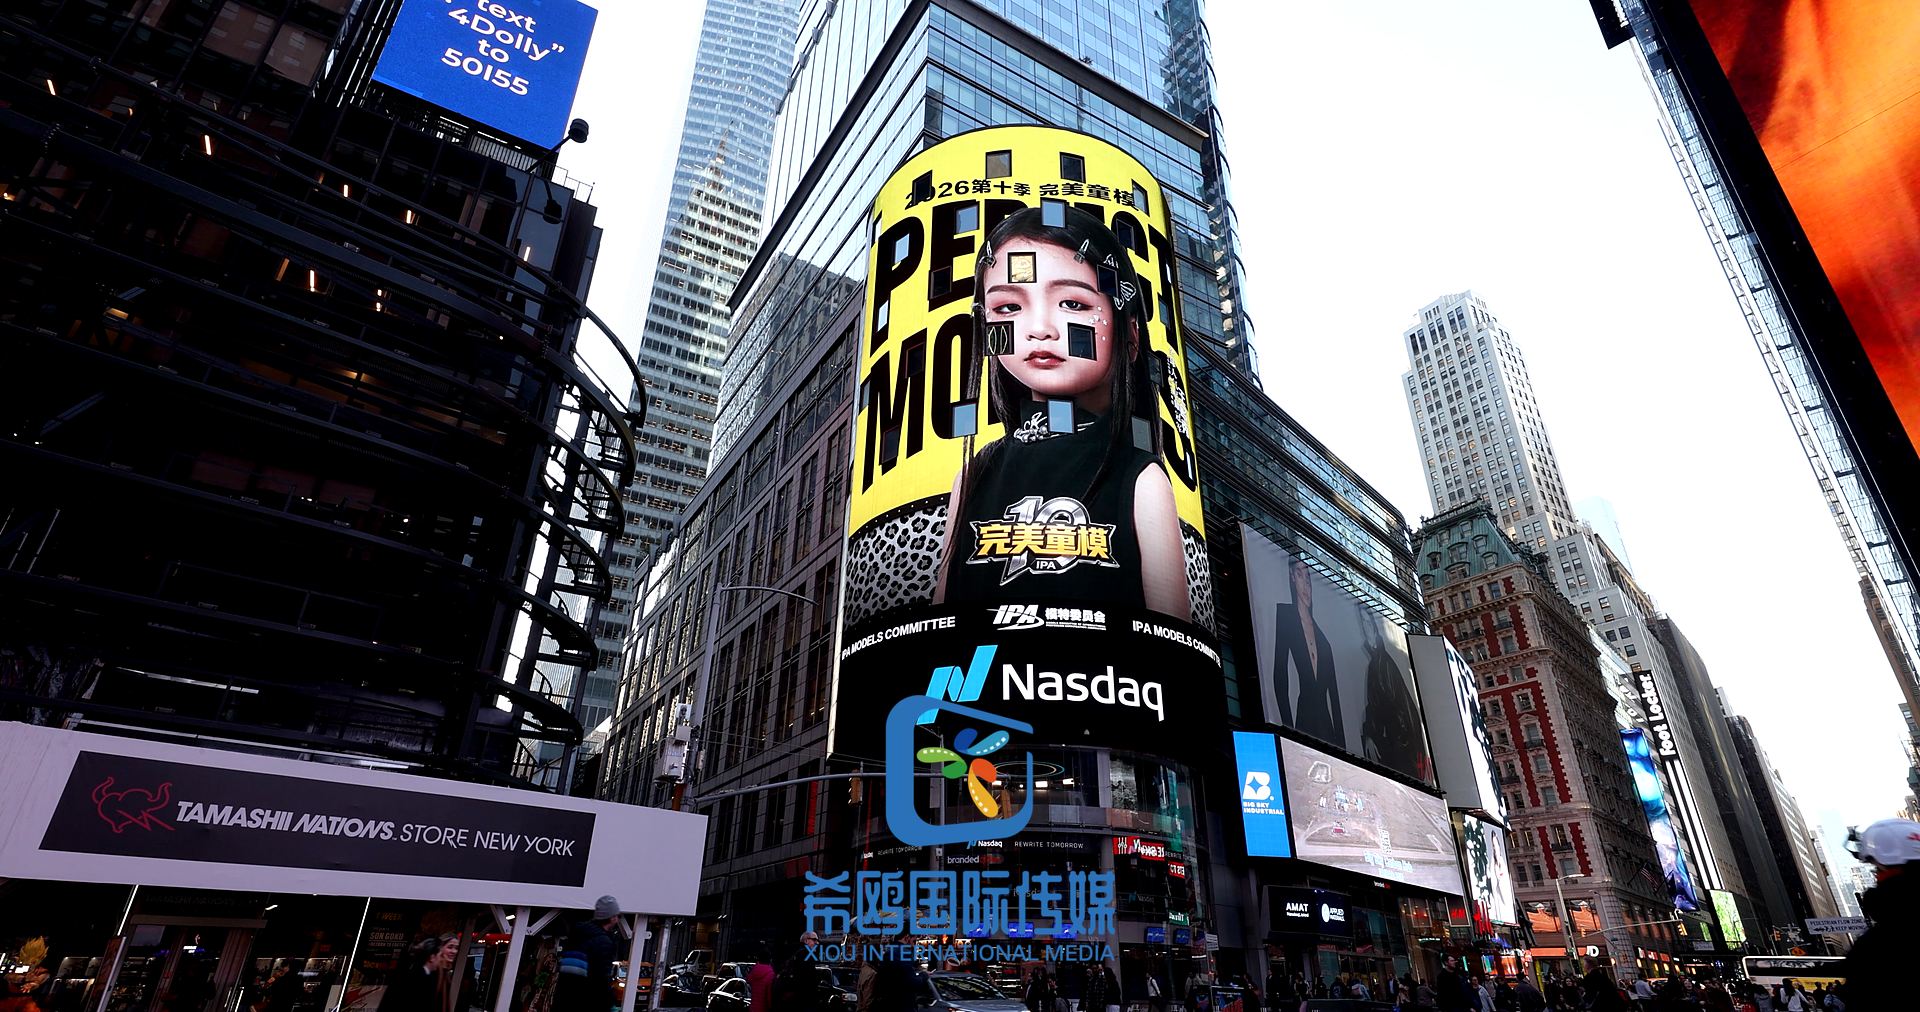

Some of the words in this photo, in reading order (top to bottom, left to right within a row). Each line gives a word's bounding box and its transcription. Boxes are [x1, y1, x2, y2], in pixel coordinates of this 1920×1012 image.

[476, 0, 537, 33] text
[478, 38, 510, 63] to
[977, 522, 1111, 560] 完美童模
[1036, 560, 1057, 570] IPA
[992, 604, 1040, 625] IPA
[851, 632, 884, 654] MODELS
[885, 616, 956, 640] COMMITTEE
[1132, 620, 1152, 635] IPA
[1153, 624, 1193, 647] MODELS
[1002, 663, 1165, 722] Nasdaq
[1652, 723, 1677, 756] Foot
[176, 800, 294, 831] TAMASHII
[399, 823, 470, 849] STORE
[473, 830, 521, 852] NEW
[524, 835, 576, 857] YORK
[977, 840, 1003, 849] Nasdaq
[947, 855, 980, 864] branded
[1286, 902, 1309, 912] AMAT
